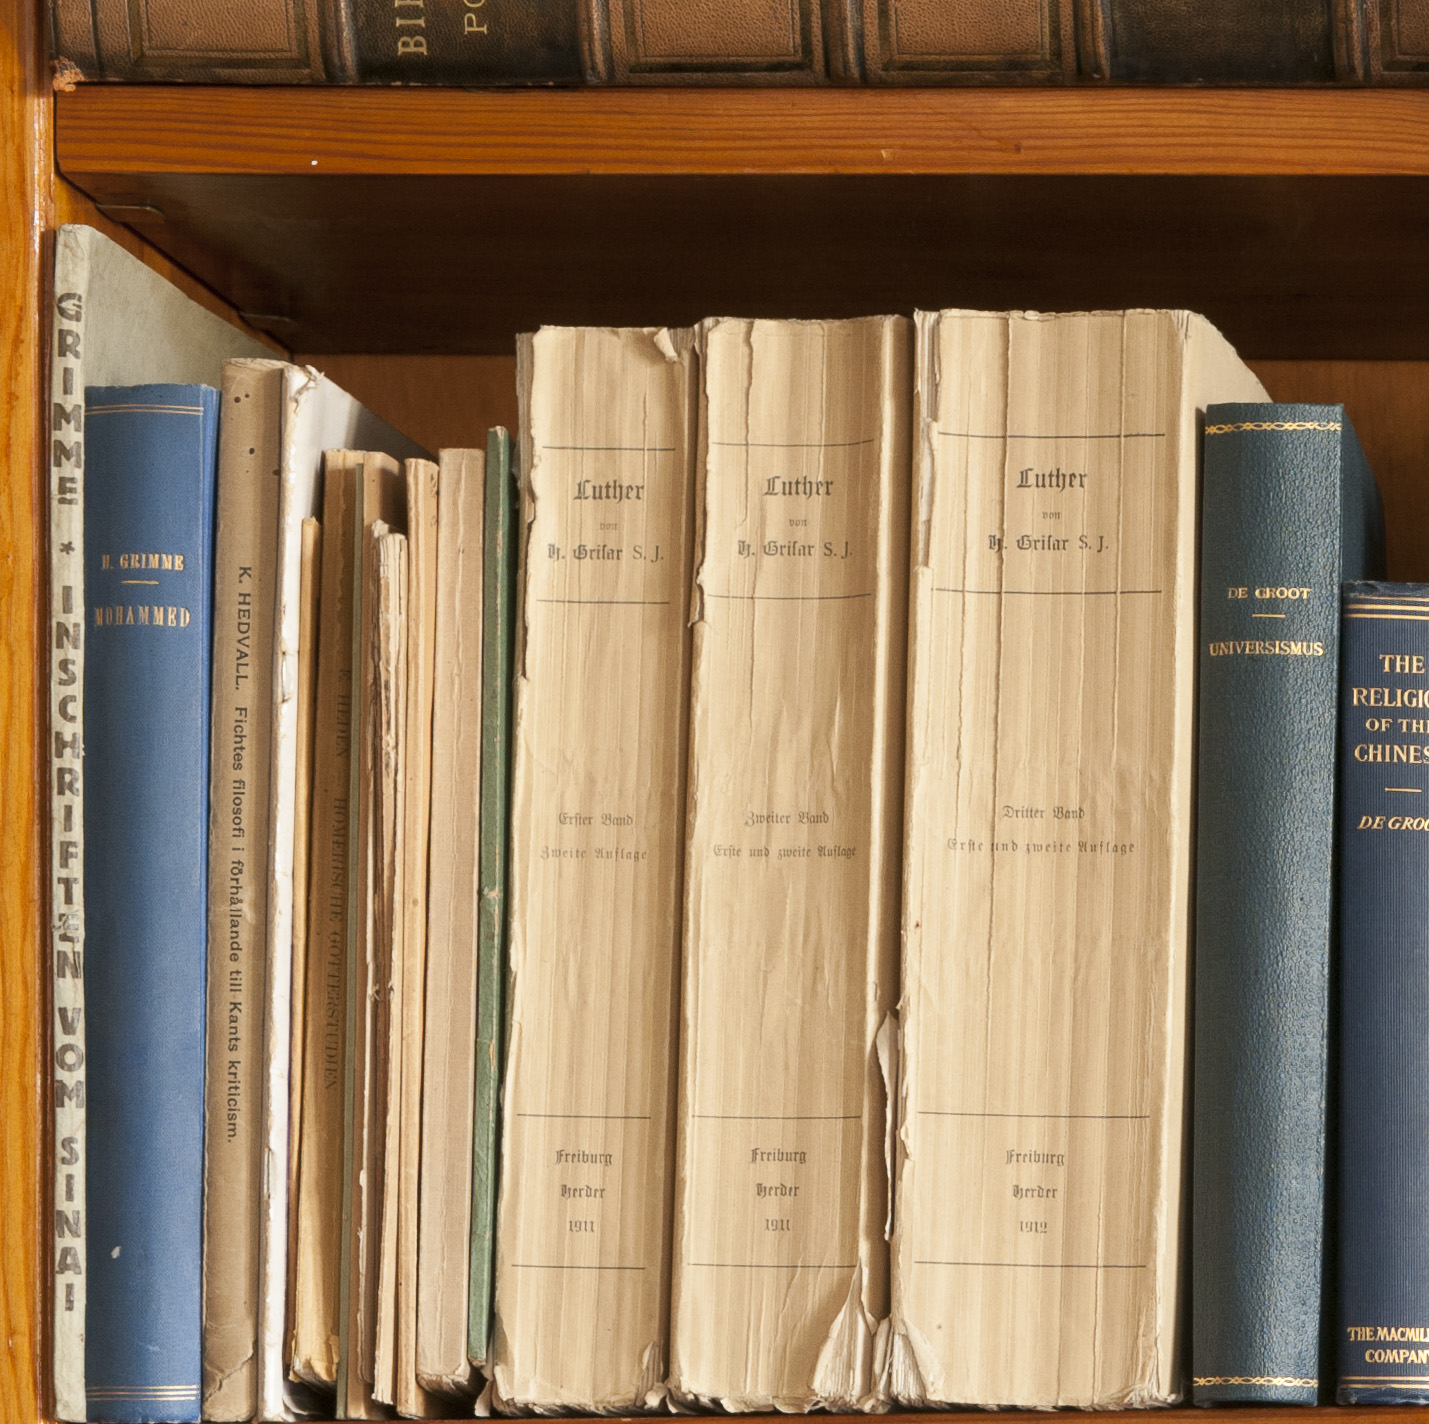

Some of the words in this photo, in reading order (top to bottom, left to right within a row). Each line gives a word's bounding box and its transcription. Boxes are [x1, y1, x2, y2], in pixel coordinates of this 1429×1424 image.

[54, 293, 83, 505] GRIMME
[573, 479, 645, 501] Luther
[762, 475, 833, 497] Luther
[1016, 468, 1087, 492] Luther
[119, 553, 184, 571] GRIMME
[1228, 587, 1247, 600] DE
[1255, 587, 1311, 600] GROOT
[94, 606, 191, 628] MOHAMMED
[235, 593, 251, 690] HEDVALL.
[1210, 641, 1324, 657] UNIVERSISMUS
[1379, 655, 1425, 674] THE
[1366, 719, 1392, 731] OF
[232, 706, 247, 771] Fichtes
[54, 585, 82, 980] INSCHRIFTEN
[232, 779, 245, 838] filosofi
[1357, 816, 1385, 830] DE
[229, 859, 245, 963] förhållande
[227, 1001, 243, 1052] Kants
[54, 1007, 84, 1108] VOM
[227, 1060, 241, 1143] kriticism.
[55, 1136, 83, 1311] SINAI
[1348, 1327, 1375, 1341] THE
